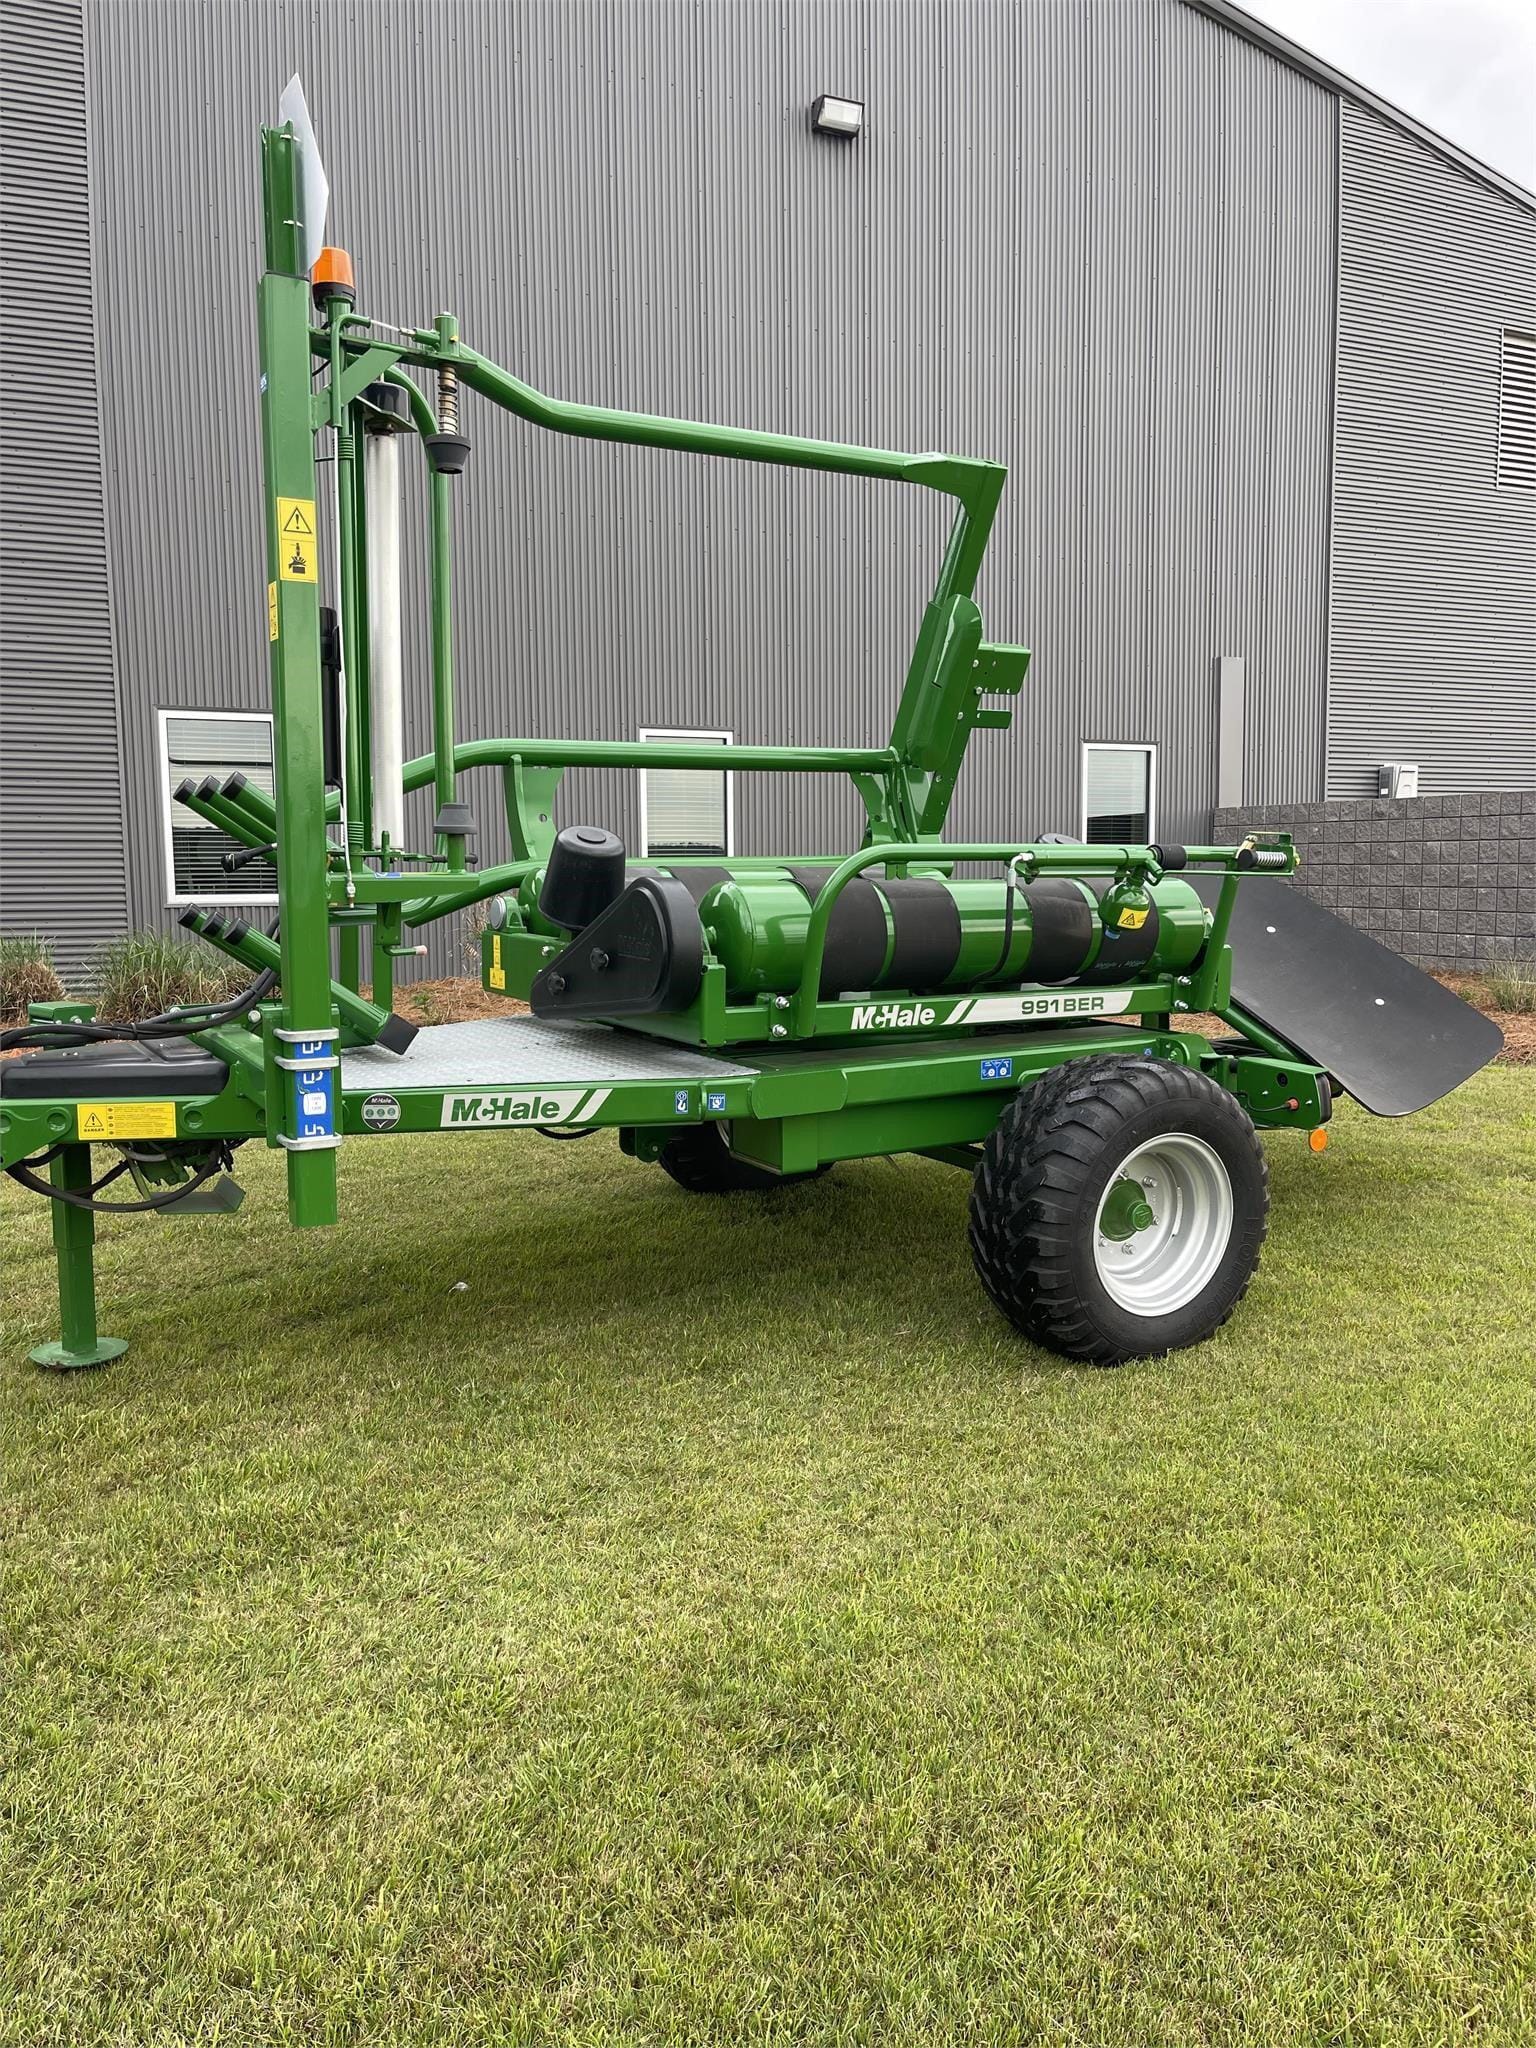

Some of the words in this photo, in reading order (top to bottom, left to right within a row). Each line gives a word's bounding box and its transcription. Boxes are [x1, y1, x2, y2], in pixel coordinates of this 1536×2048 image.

[851, 1004, 936, 1030] McHale
[1021, 997, 1104, 1015] 991BER
[451, 1096, 560, 1122] McHale
